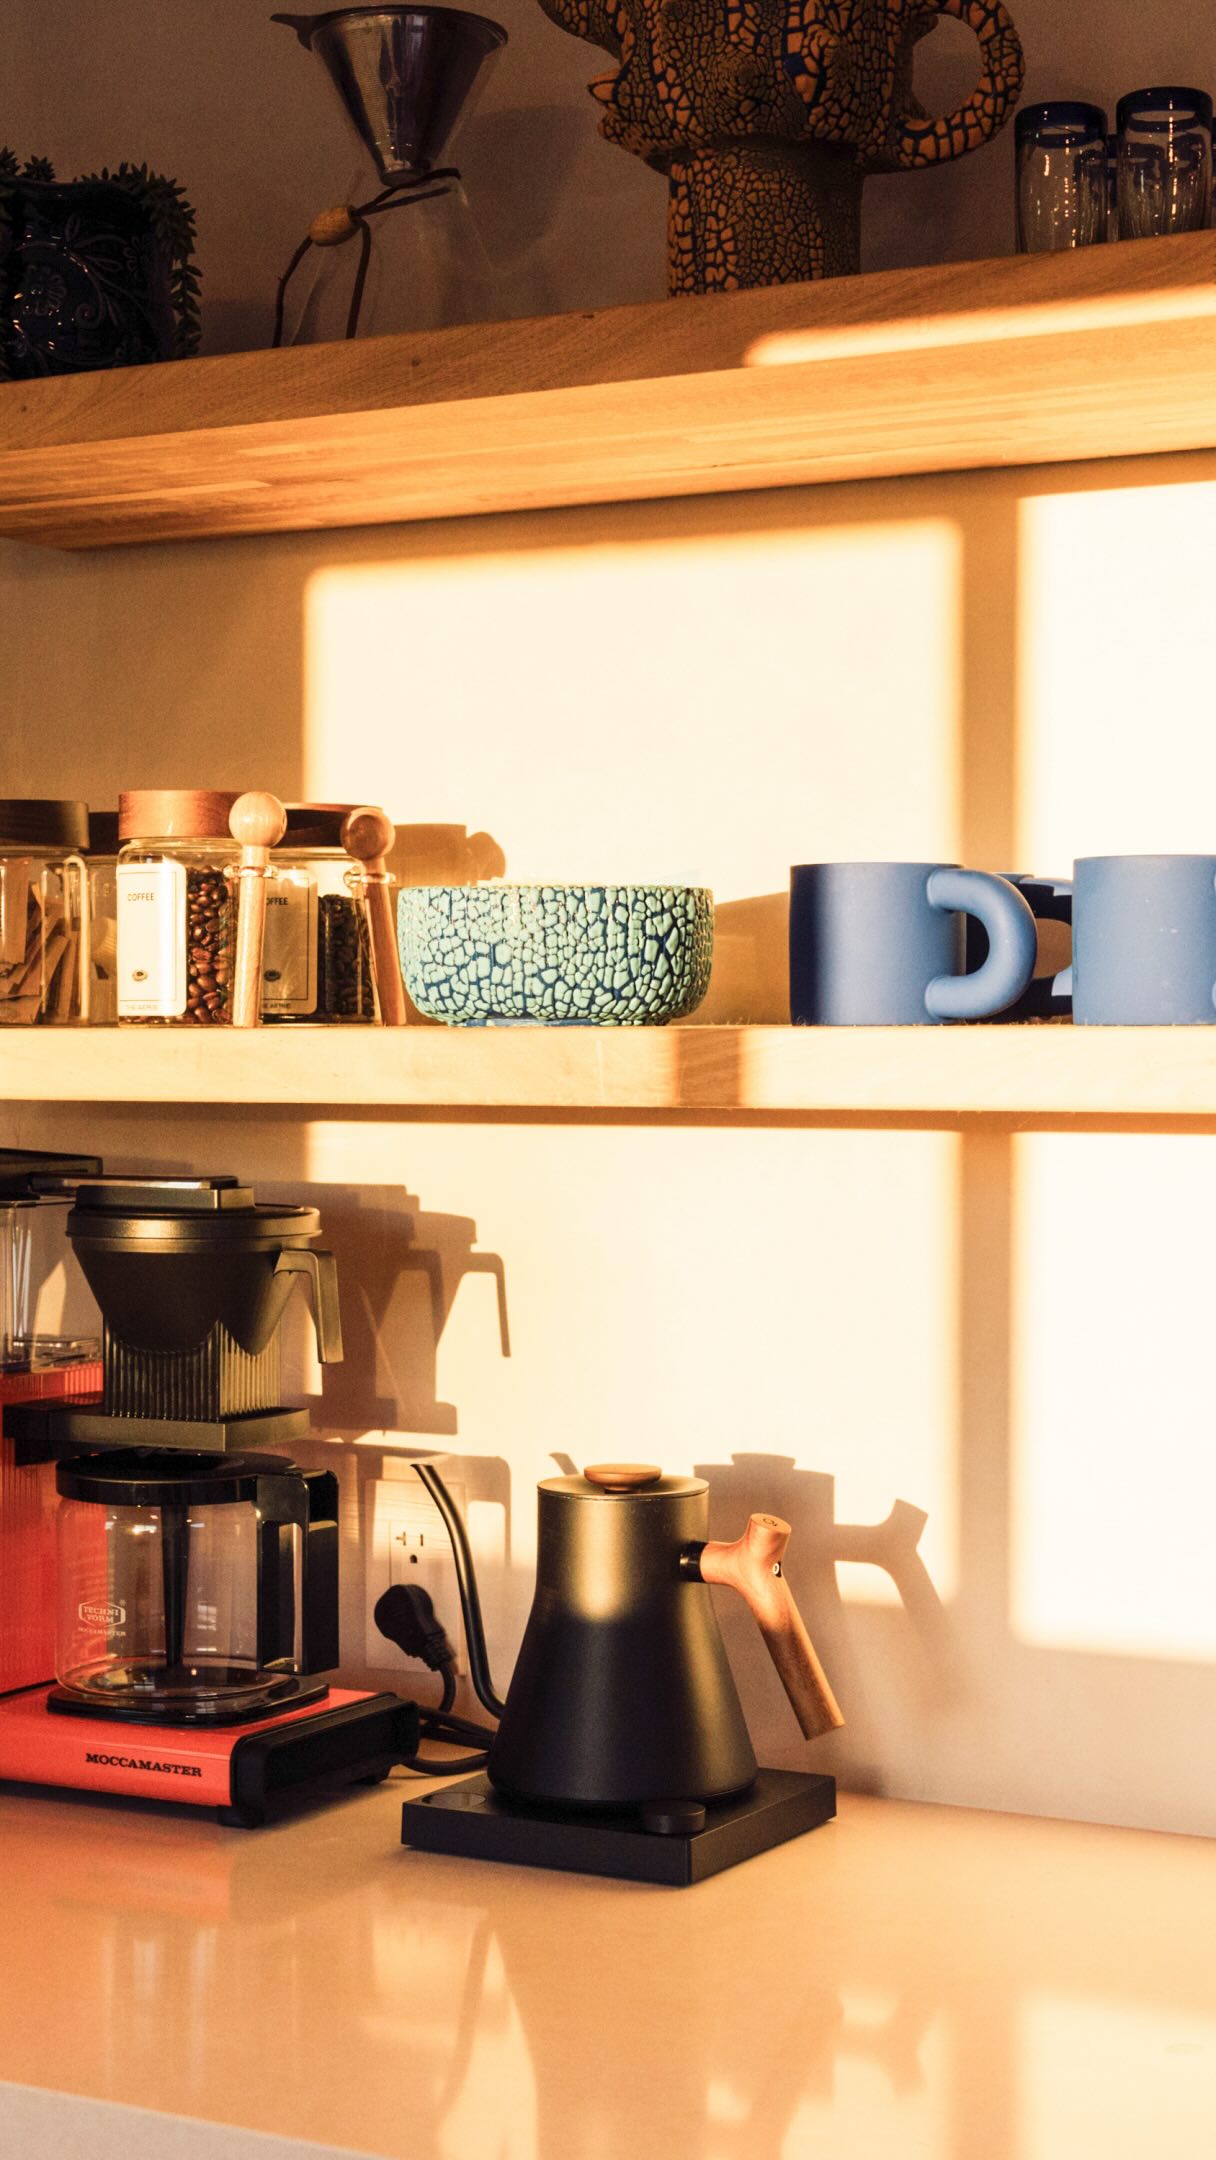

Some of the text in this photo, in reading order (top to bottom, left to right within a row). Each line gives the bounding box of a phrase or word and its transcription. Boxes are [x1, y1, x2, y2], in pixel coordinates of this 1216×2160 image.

[127, 892, 155, 902] COFFEE
[265, 896, 289, 906] OFFEE
[83, 1605, 119, 1616] TECHNI
[86, 1753, 202, 1778] MOCCAMASTER
